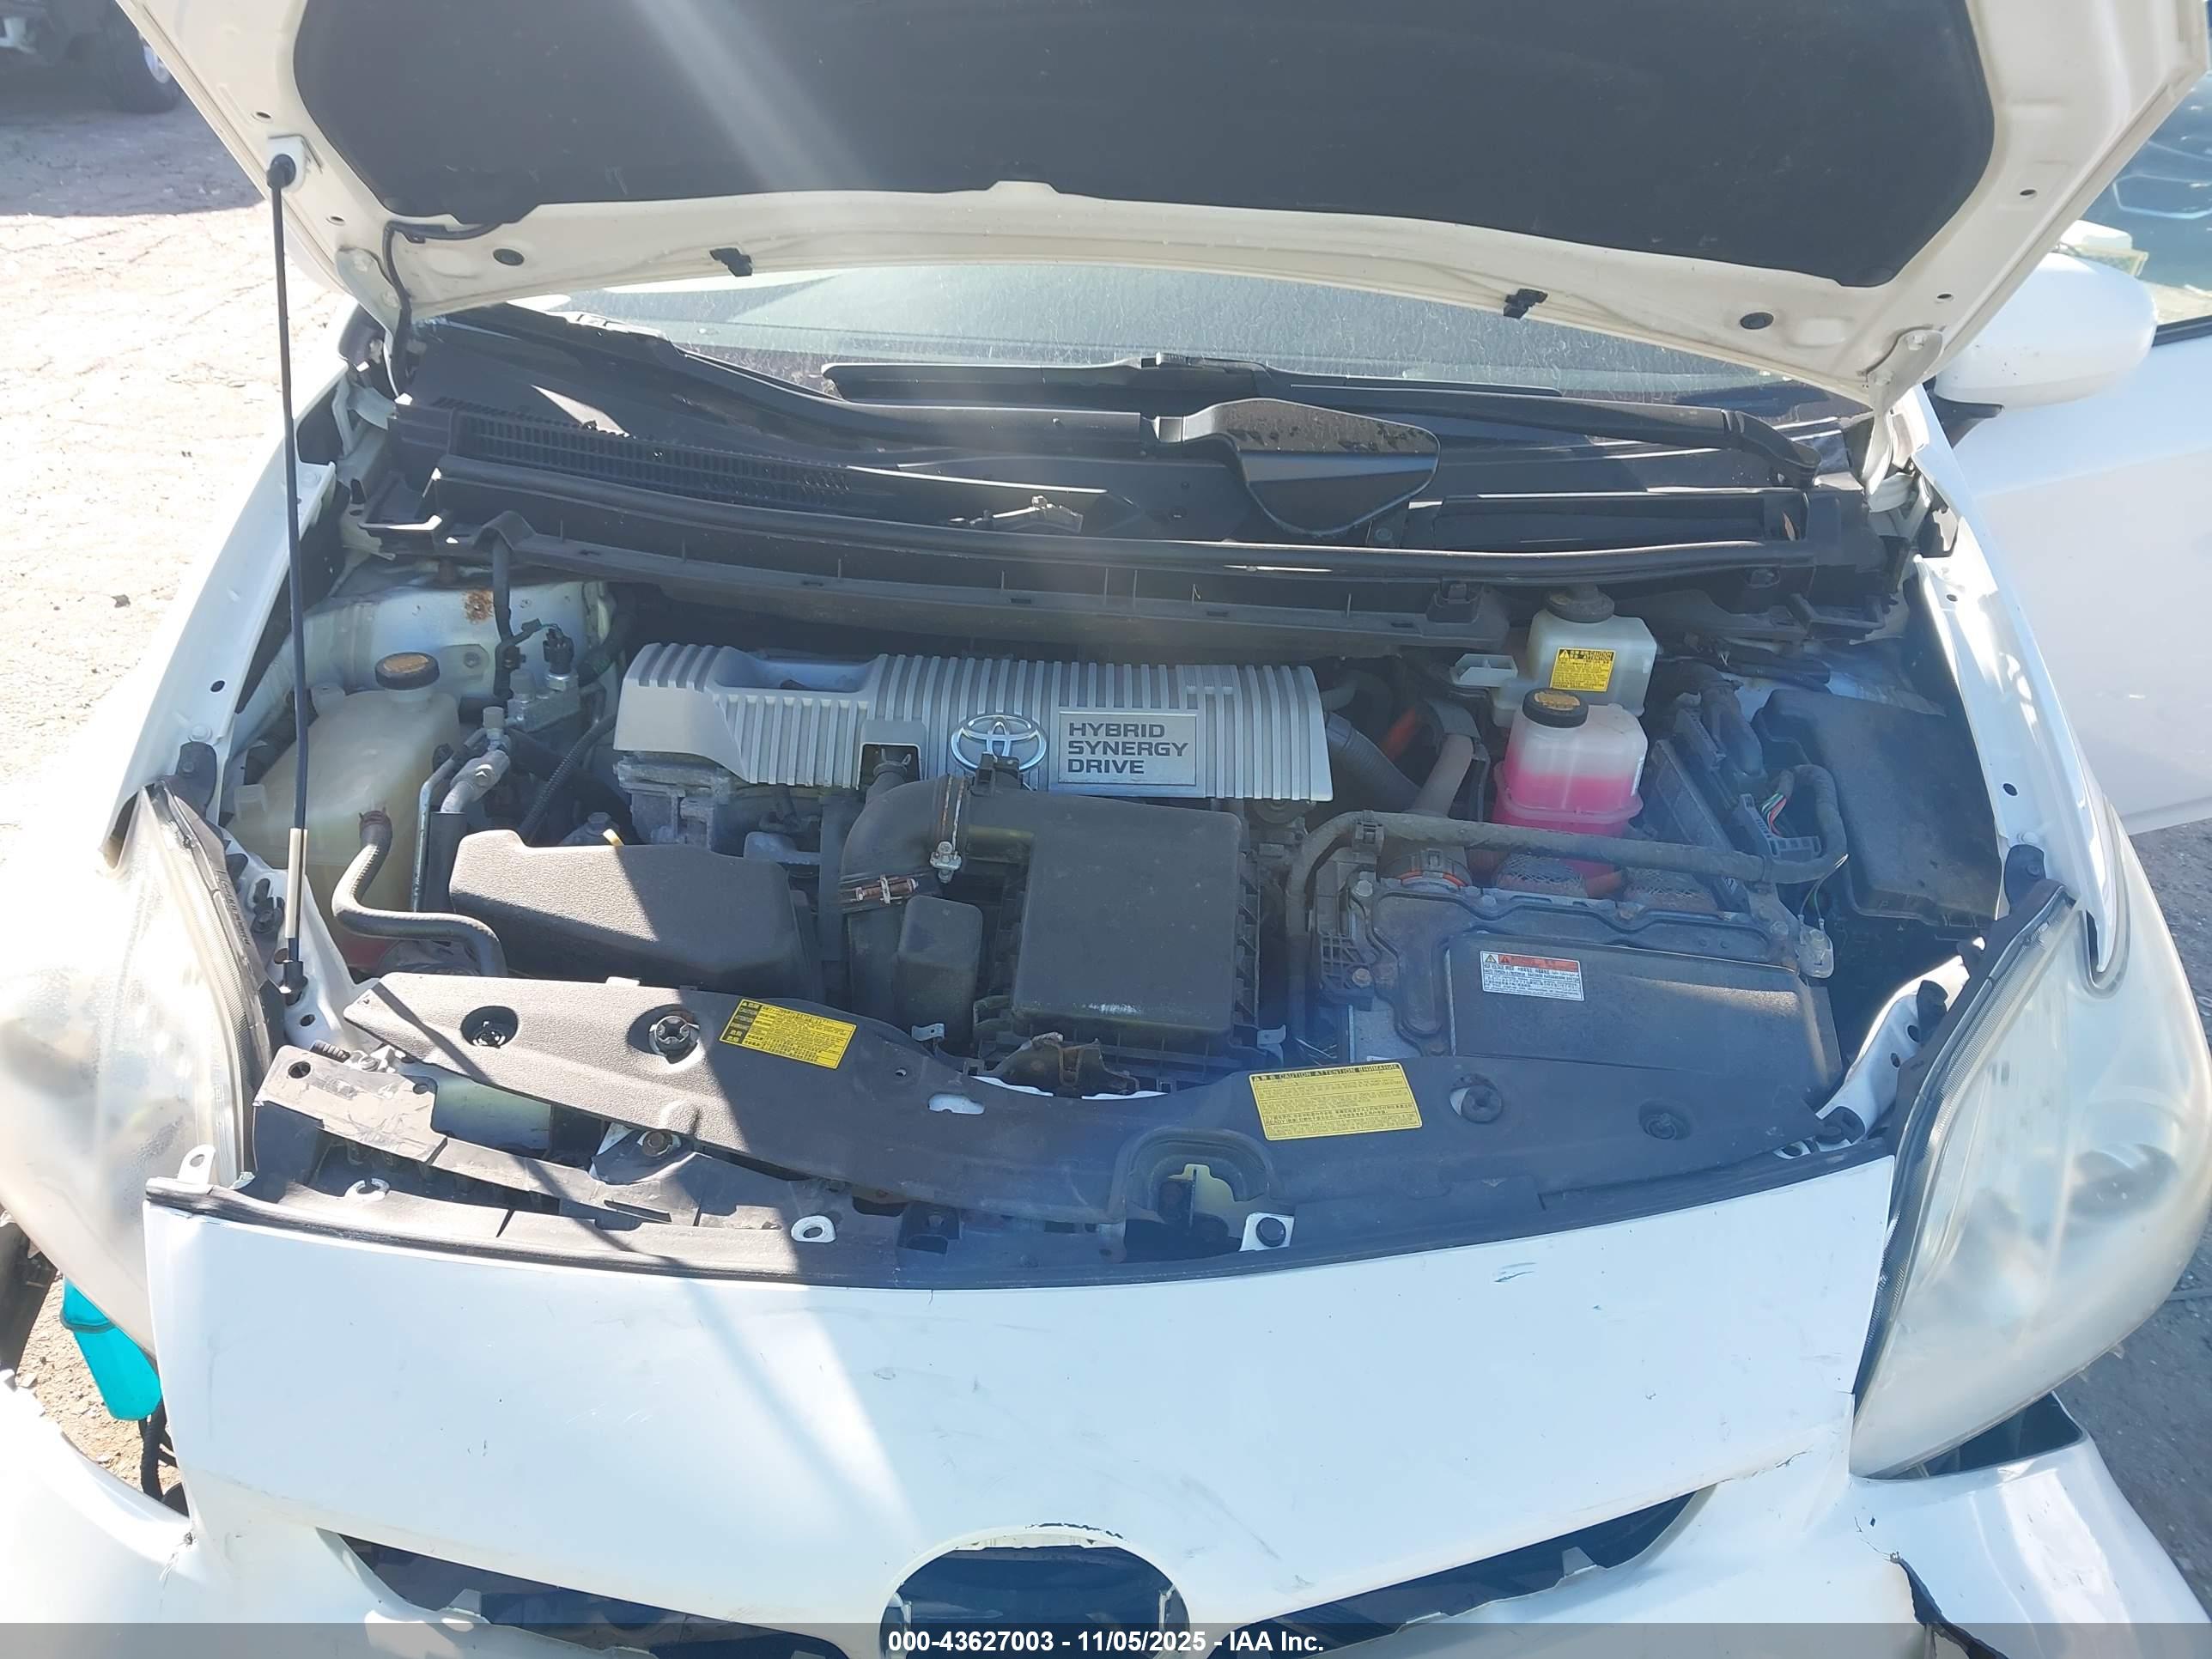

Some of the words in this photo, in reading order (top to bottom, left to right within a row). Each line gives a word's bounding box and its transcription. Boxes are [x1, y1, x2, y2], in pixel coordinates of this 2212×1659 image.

[1069, 722, 1165, 738] HYBRID
[1068, 740, 1188, 757] SYNERGY
[1068, 759, 1145, 774] DRIVE
[1279, 1070, 1312, 1079] CAUTION
[1315, 1067, 1356, 1076] ATTENTION
